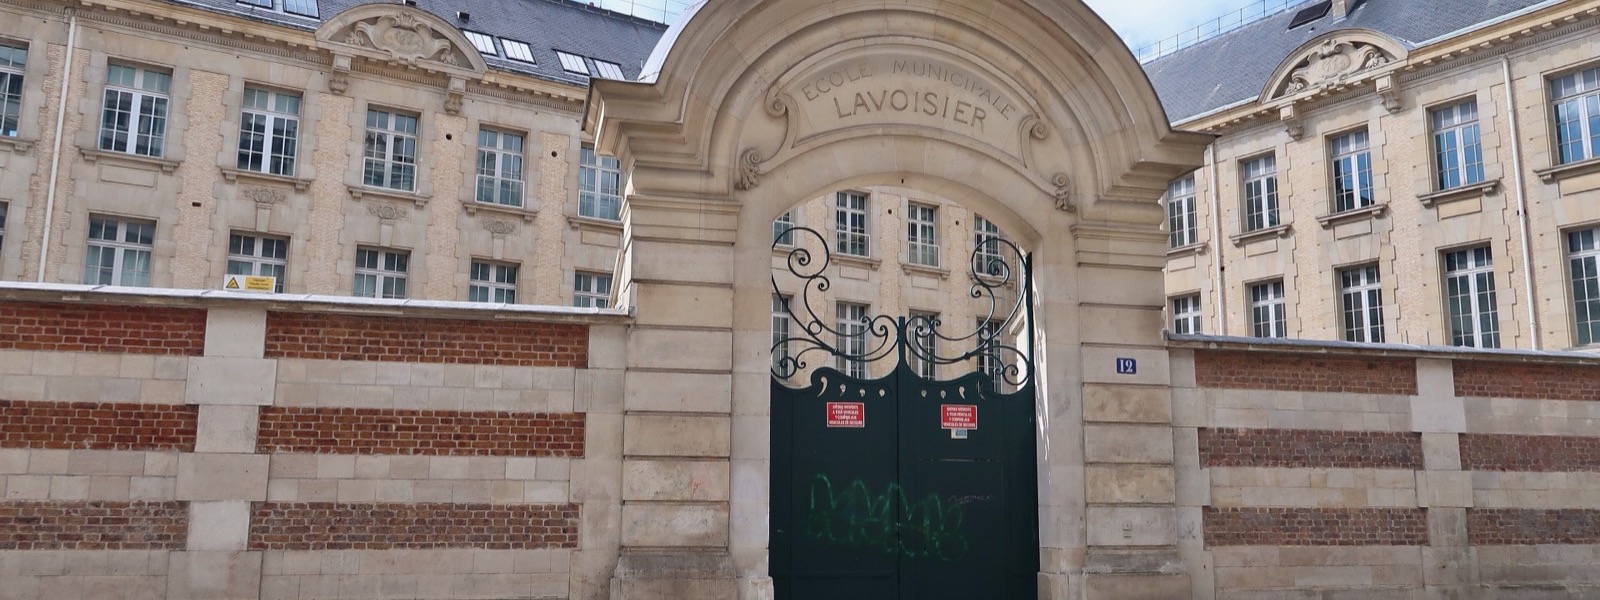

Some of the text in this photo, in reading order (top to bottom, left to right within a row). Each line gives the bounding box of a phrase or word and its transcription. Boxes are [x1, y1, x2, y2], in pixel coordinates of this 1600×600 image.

[833, 89, 987, 134] LAVOISIER
[892, 60, 1016, 121] MUNICIPALE
[1120, 359, 1133, 373] 12
